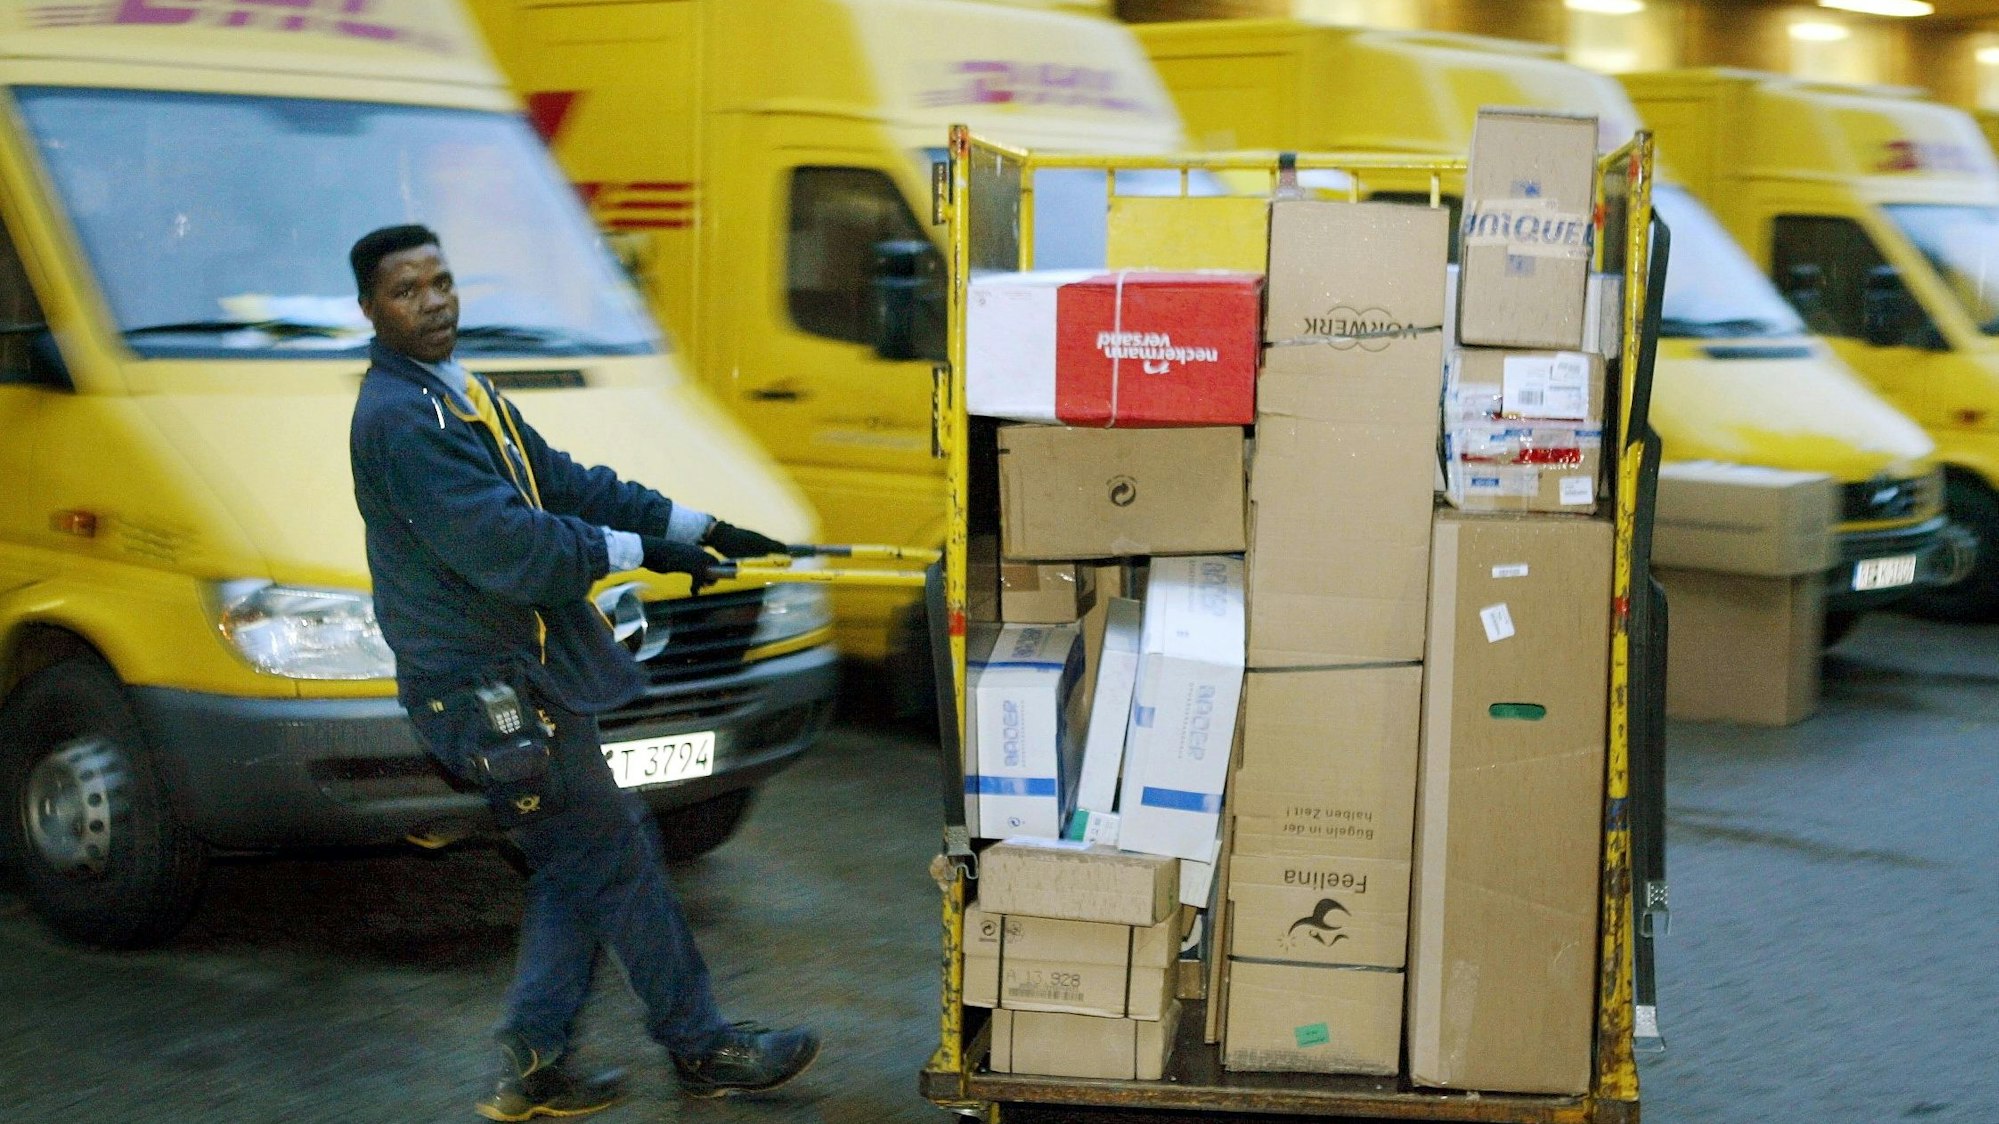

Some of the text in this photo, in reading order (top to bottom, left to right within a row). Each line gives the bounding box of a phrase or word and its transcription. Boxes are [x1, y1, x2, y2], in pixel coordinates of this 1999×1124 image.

[1096, 331, 1170, 349] versand
[1104, 347, 1218, 365] neckermann
[644, 739, 708, 777] 3794
[1326, 808, 1373, 822] halben
[1283, 824, 1305, 835] der
[1309, 825, 1321, 835] in
[1284, 869, 1367, 894] Feelina
